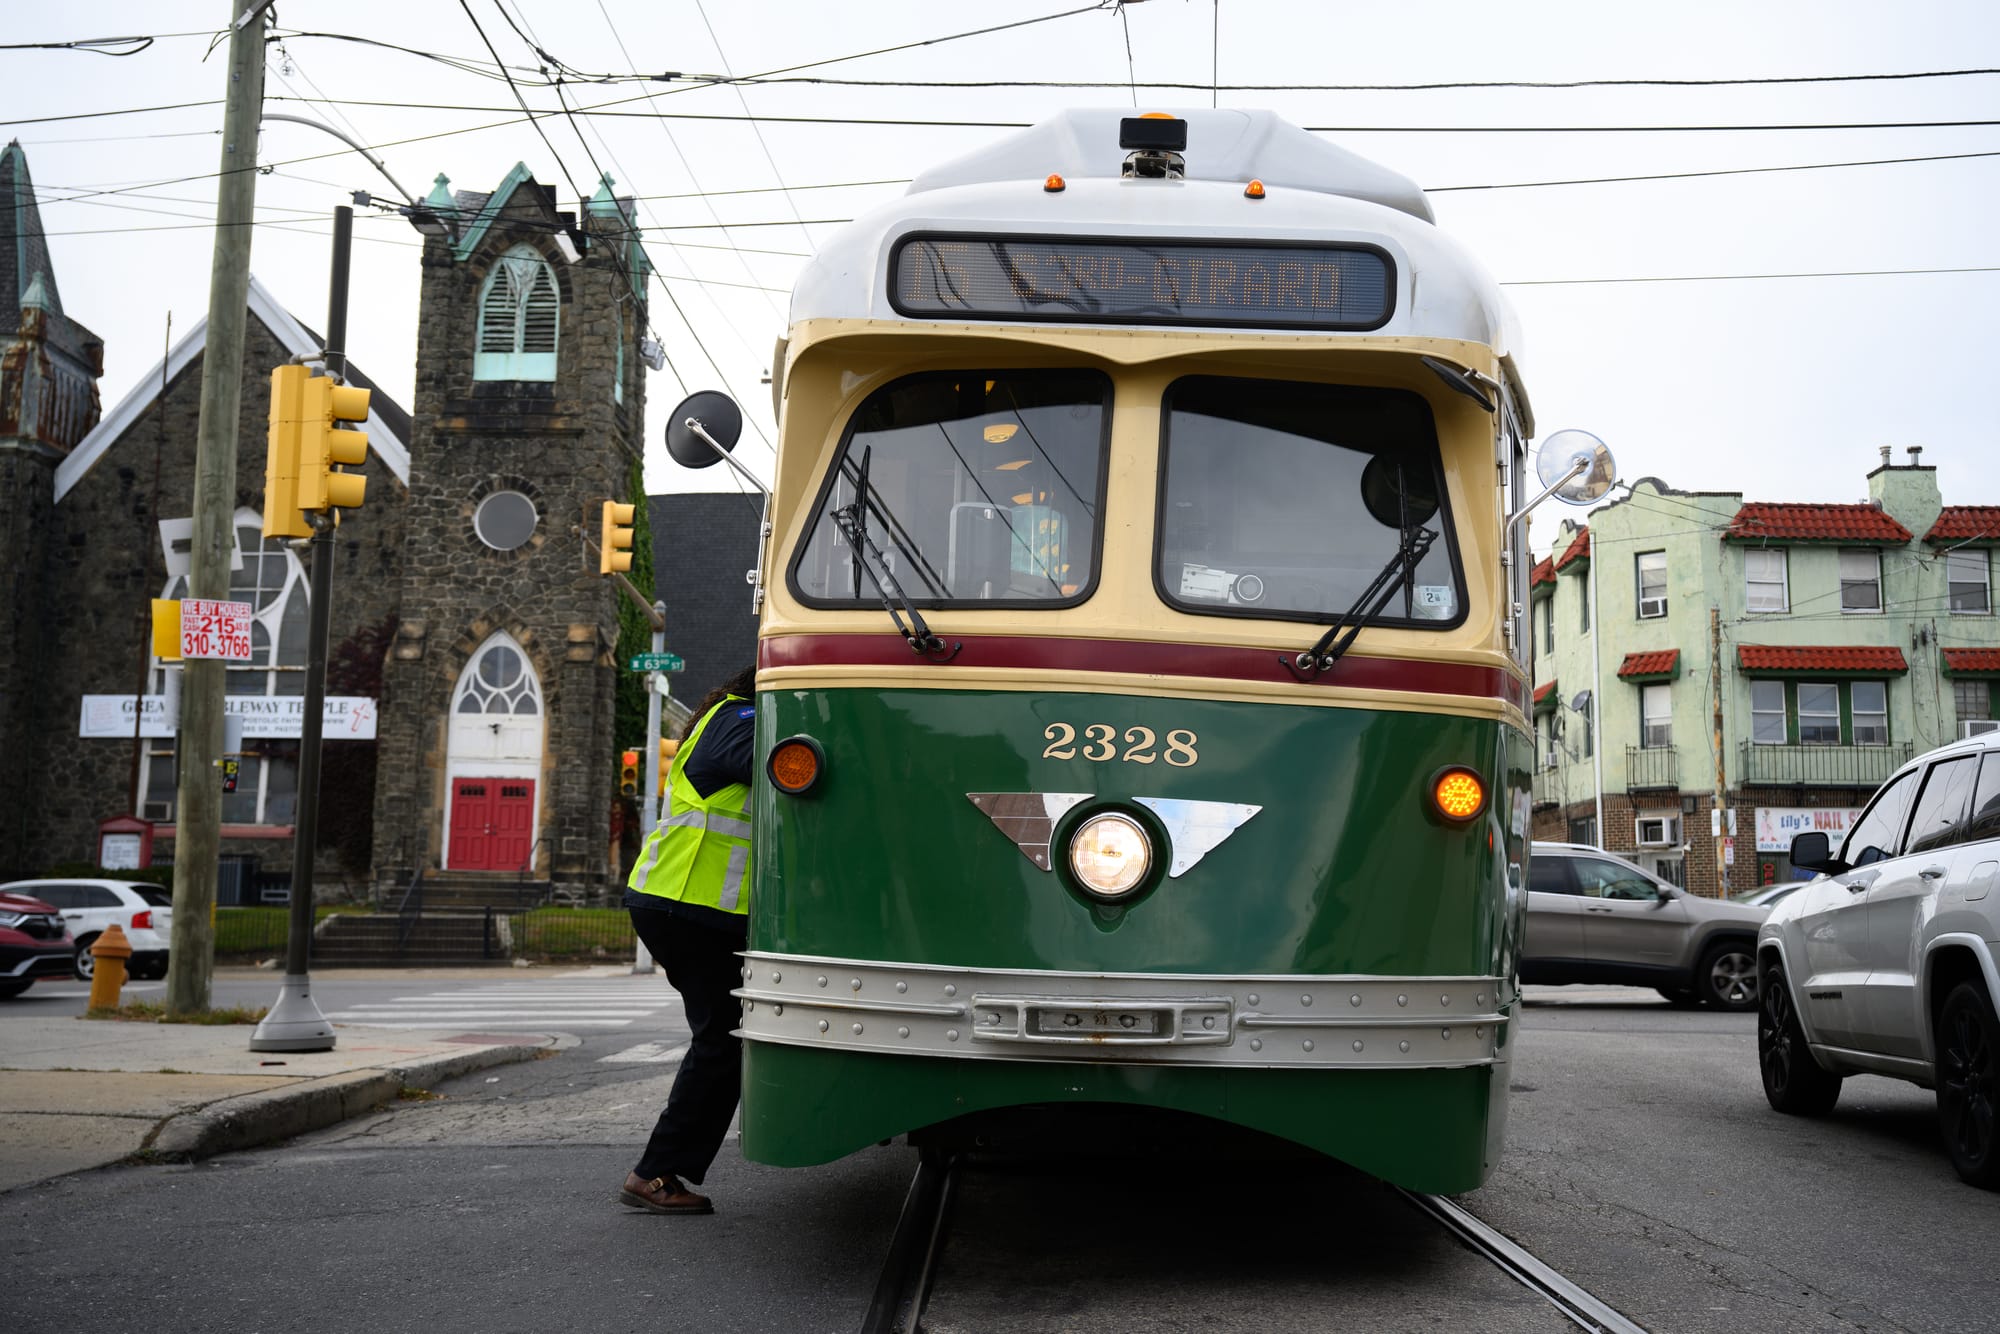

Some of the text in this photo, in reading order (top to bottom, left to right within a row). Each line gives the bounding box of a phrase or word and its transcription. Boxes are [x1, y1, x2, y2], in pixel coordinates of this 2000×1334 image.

[906, 244, 971, 302] 15
[183, 601, 249, 618] WE BUY HOUSES
[200, 616, 235, 634] 215
[286, 701, 349, 714] TEPLE
[1041, 721, 1200, 768] 2328
[1781, 814, 1810, 829] Lily's
[1814, 811, 1844, 830] NAIL
